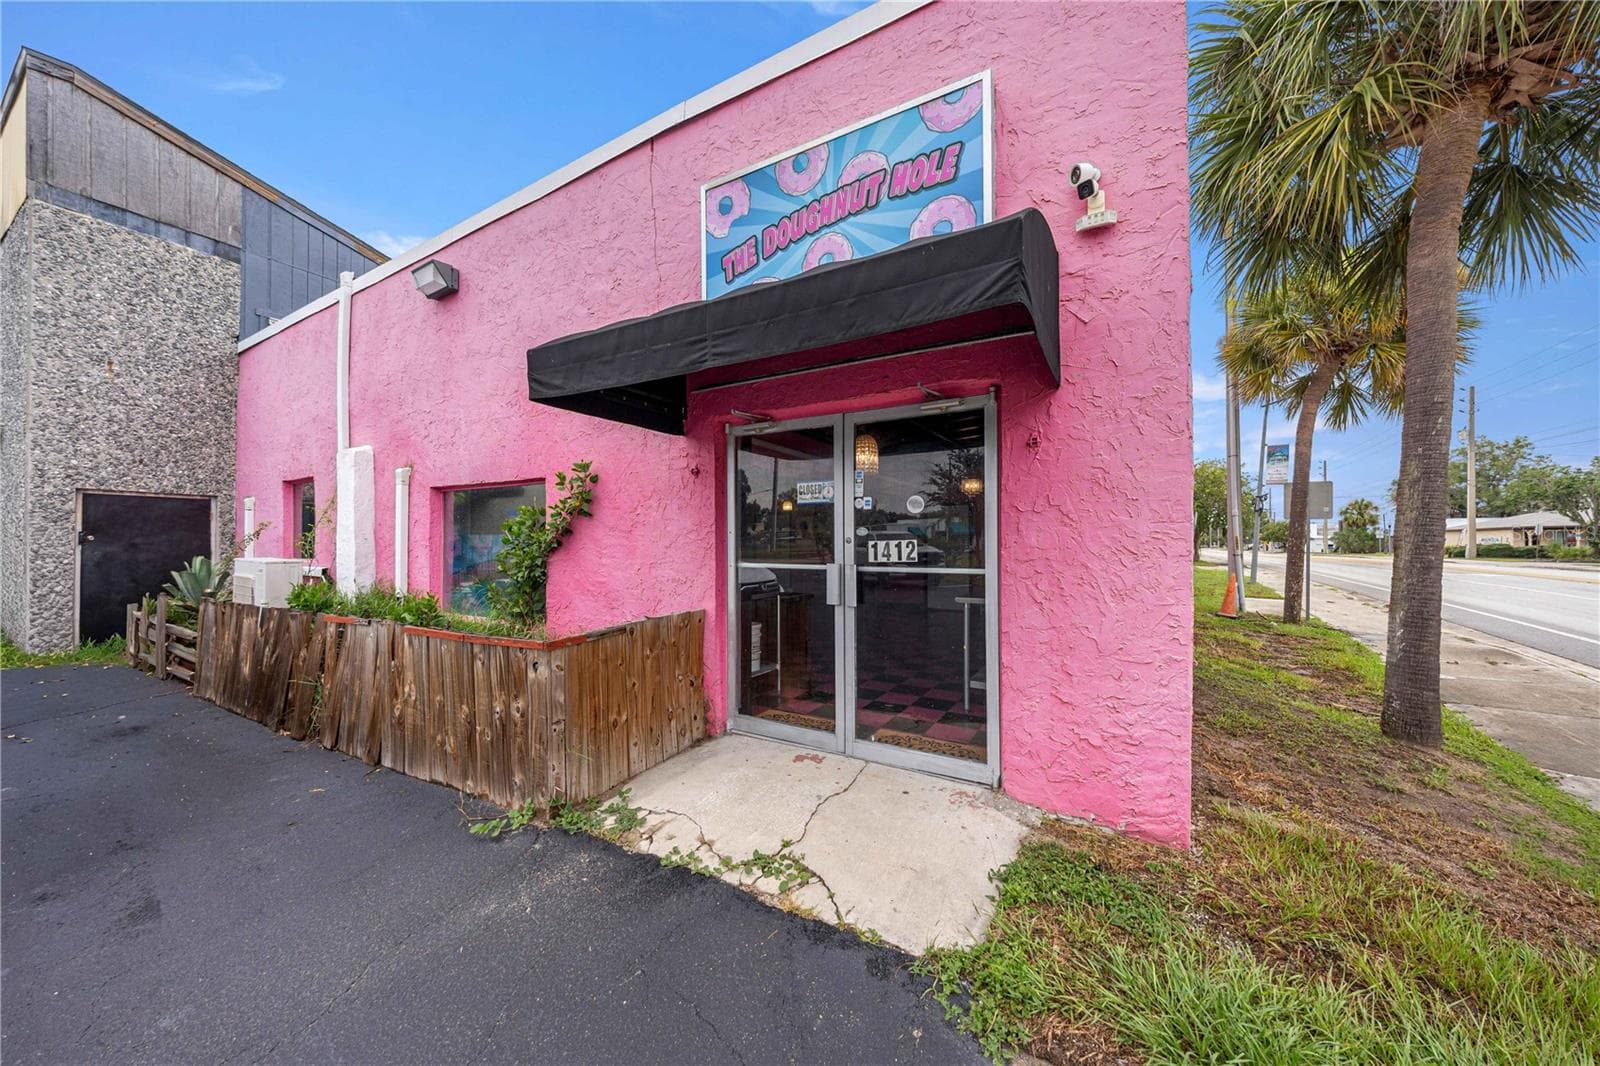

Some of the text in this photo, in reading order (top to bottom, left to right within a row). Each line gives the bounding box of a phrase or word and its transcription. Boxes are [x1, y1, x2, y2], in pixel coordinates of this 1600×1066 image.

[721, 141, 965, 283] THE DOUGHNUT HOLE
[799, 483, 822, 496] CLOSED
[871, 541, 917, 561] 1412
